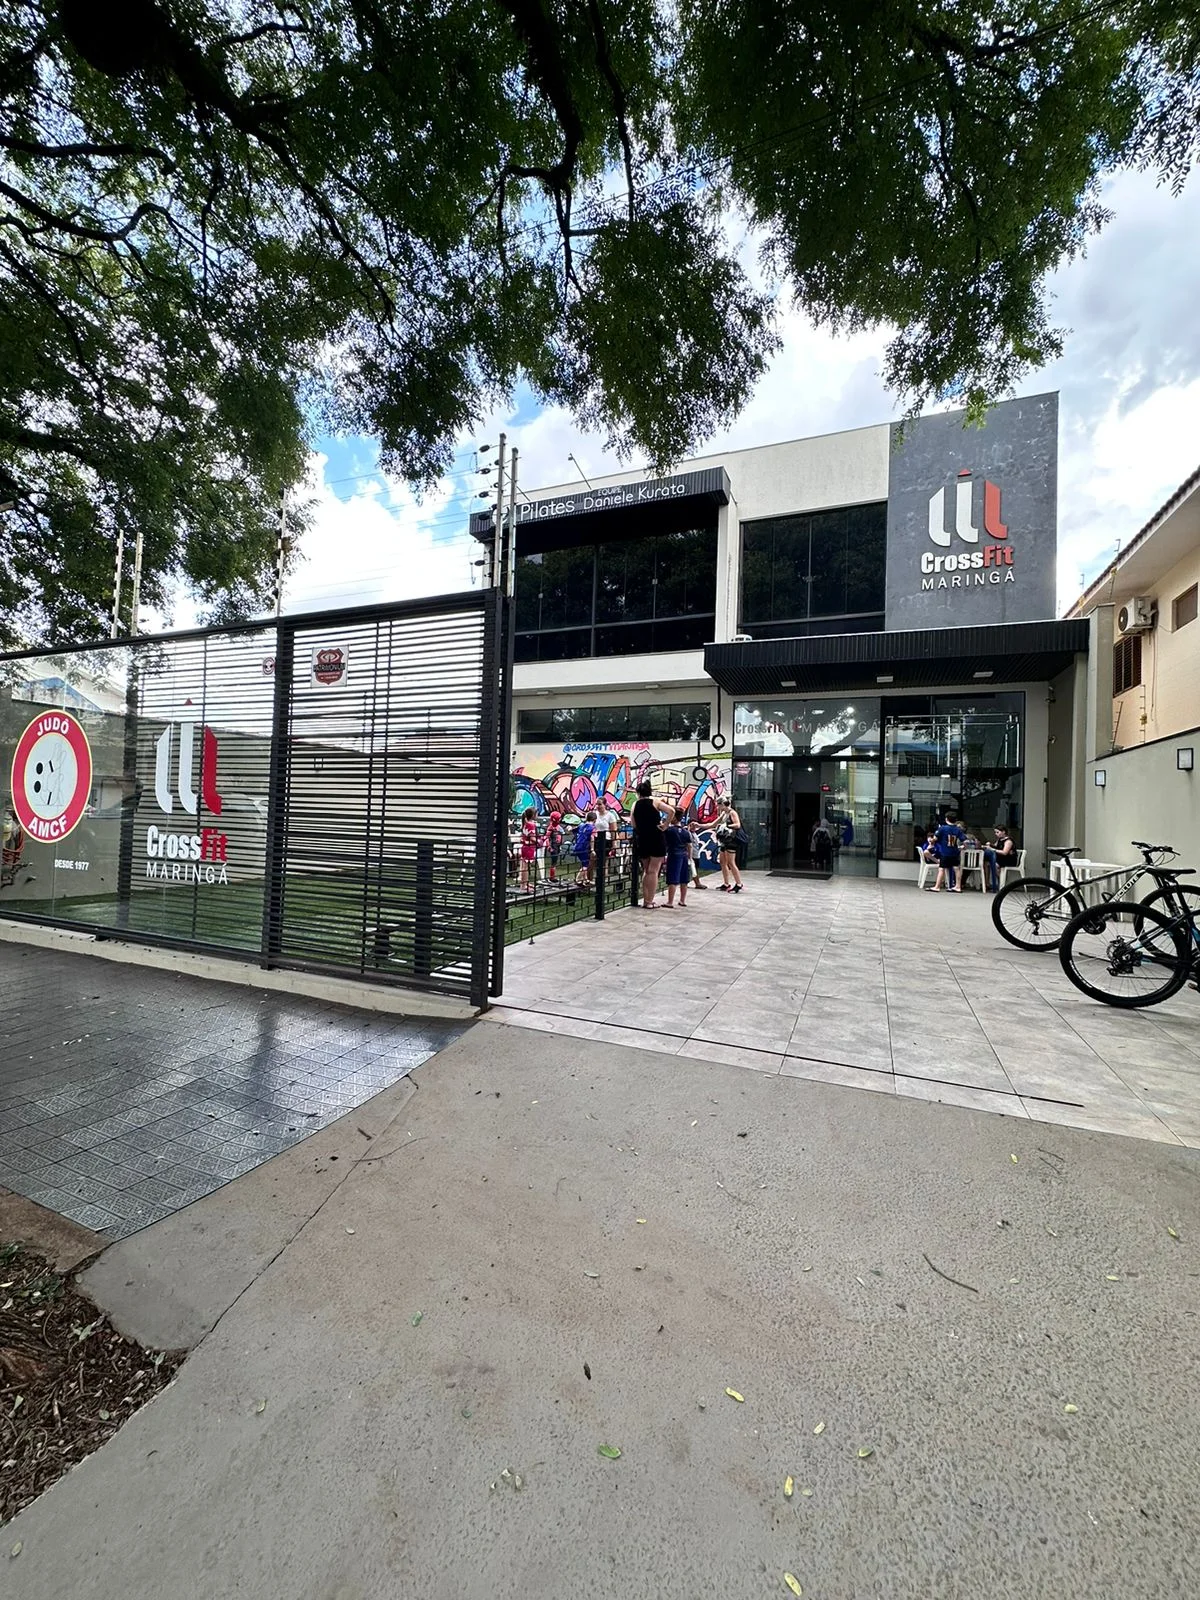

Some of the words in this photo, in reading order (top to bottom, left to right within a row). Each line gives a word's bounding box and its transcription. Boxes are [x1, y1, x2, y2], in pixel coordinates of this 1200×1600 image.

[520, 499, 575, 521] Pilates
[583, 490, 634, 510] Daniele
[638, 482, 686, 500] Kurata
[598, 485, 622, 496] EQUIPE
[920, 544, 1014, 574] CrossFit
[921, 566, 1015, 591] MARINGÁ
[37, 717, 70, 737] JUDÔ
[28, 815, 68, 838] AMCF
[146, 824, 229, 862] CrossFit
[54, 858, 74, 870] DESDE
[74, 860, 90, 871] 1977
[146, 862, 228, 885] MARINGÁ
